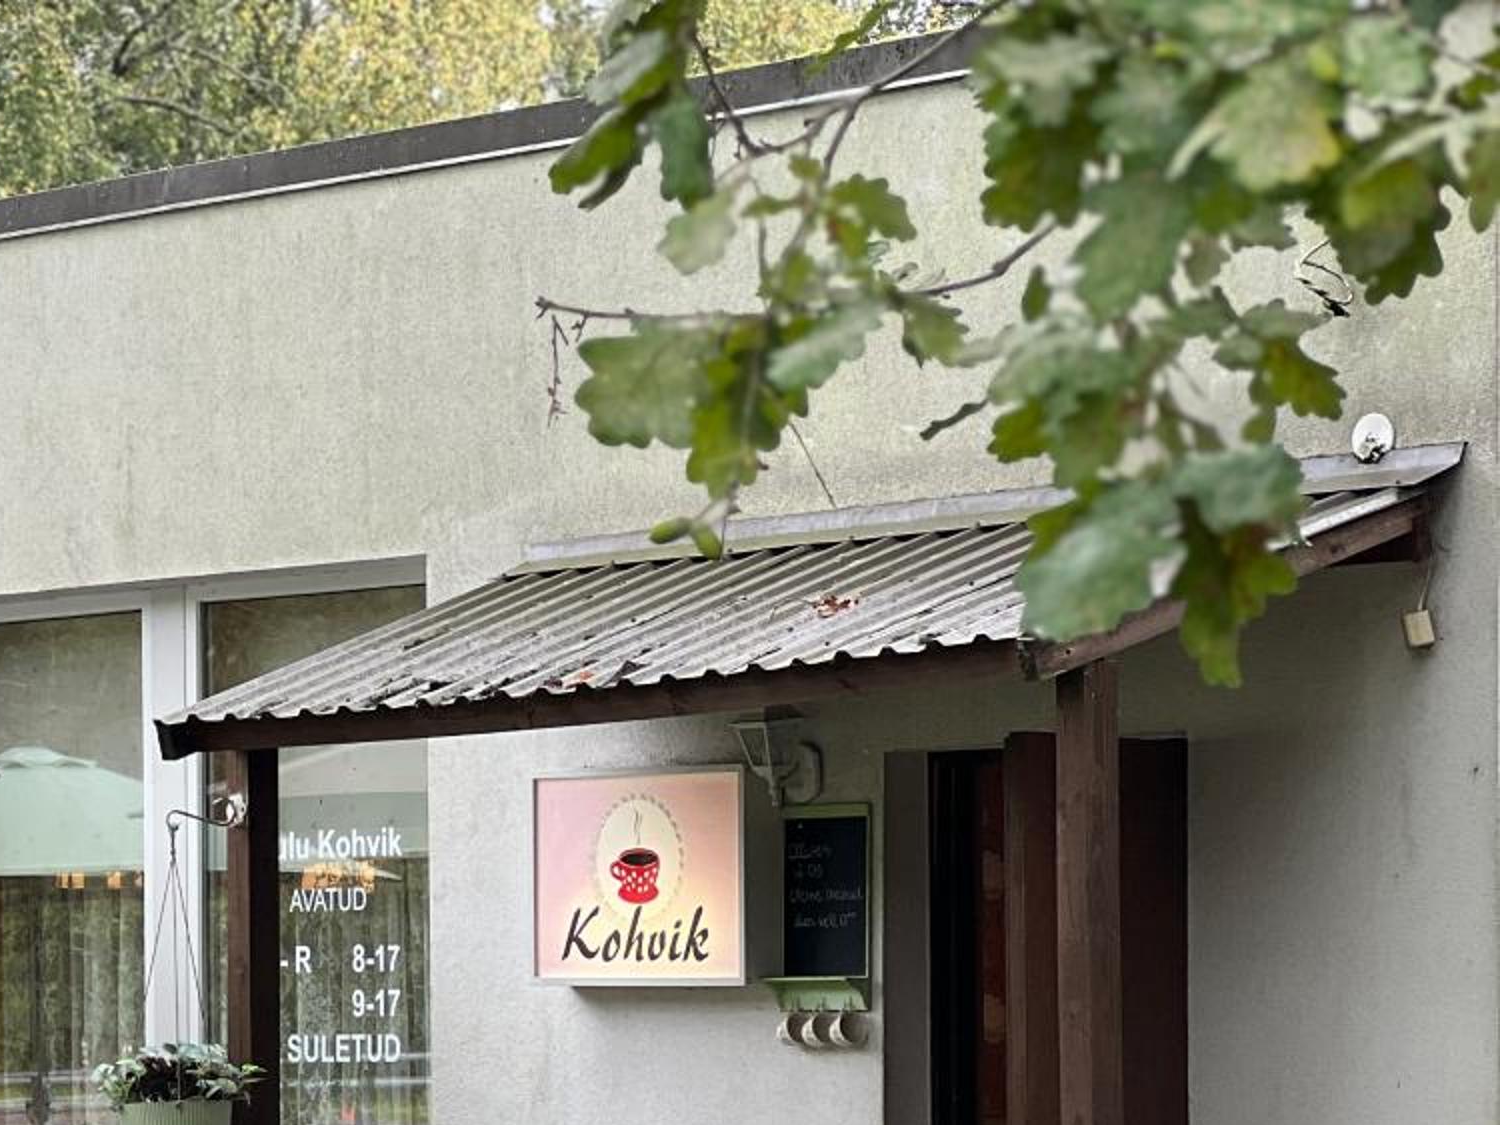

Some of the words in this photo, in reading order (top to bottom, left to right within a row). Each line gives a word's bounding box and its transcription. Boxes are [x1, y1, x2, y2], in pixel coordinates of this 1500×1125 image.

[318, 826, 402, 858] Kohvik
[289, 887, 367, 913] AVATUD
[561, 905, 709, 962] Kohvik
[352, 943, 400, 972] 8-17
[352, 989, 400, 1017] 9-17
[287, 1033, 401, 1062] SULETUD
